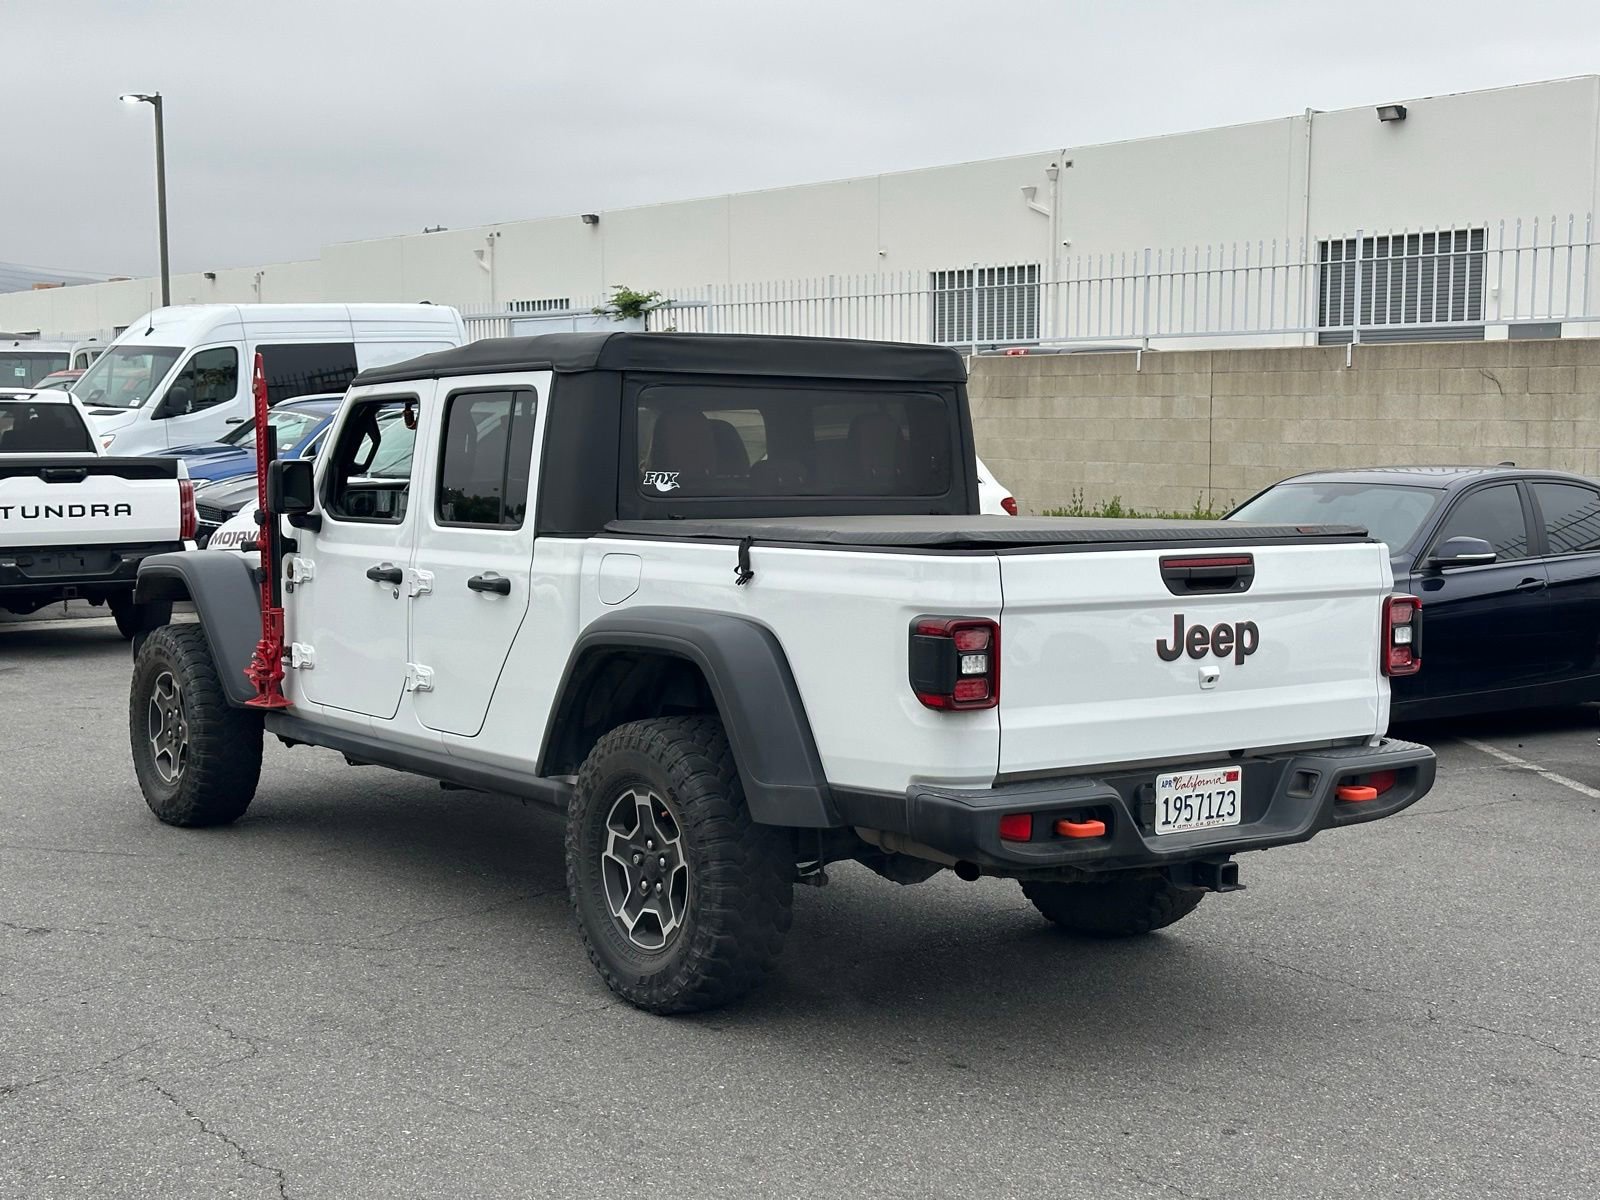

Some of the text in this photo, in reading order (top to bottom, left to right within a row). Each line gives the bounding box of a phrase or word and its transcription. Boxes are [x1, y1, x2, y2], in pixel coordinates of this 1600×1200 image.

[643, 471, 680, 488] FOX
[0, 503, 131, 519] TUNDRA
[1156, 613, 1259, 665] Jeep
[1161, 779, 1173, 788] APR
[1174, 775, 1226, 792] California
[1161, 790, 1236, 826] 19571Z3
